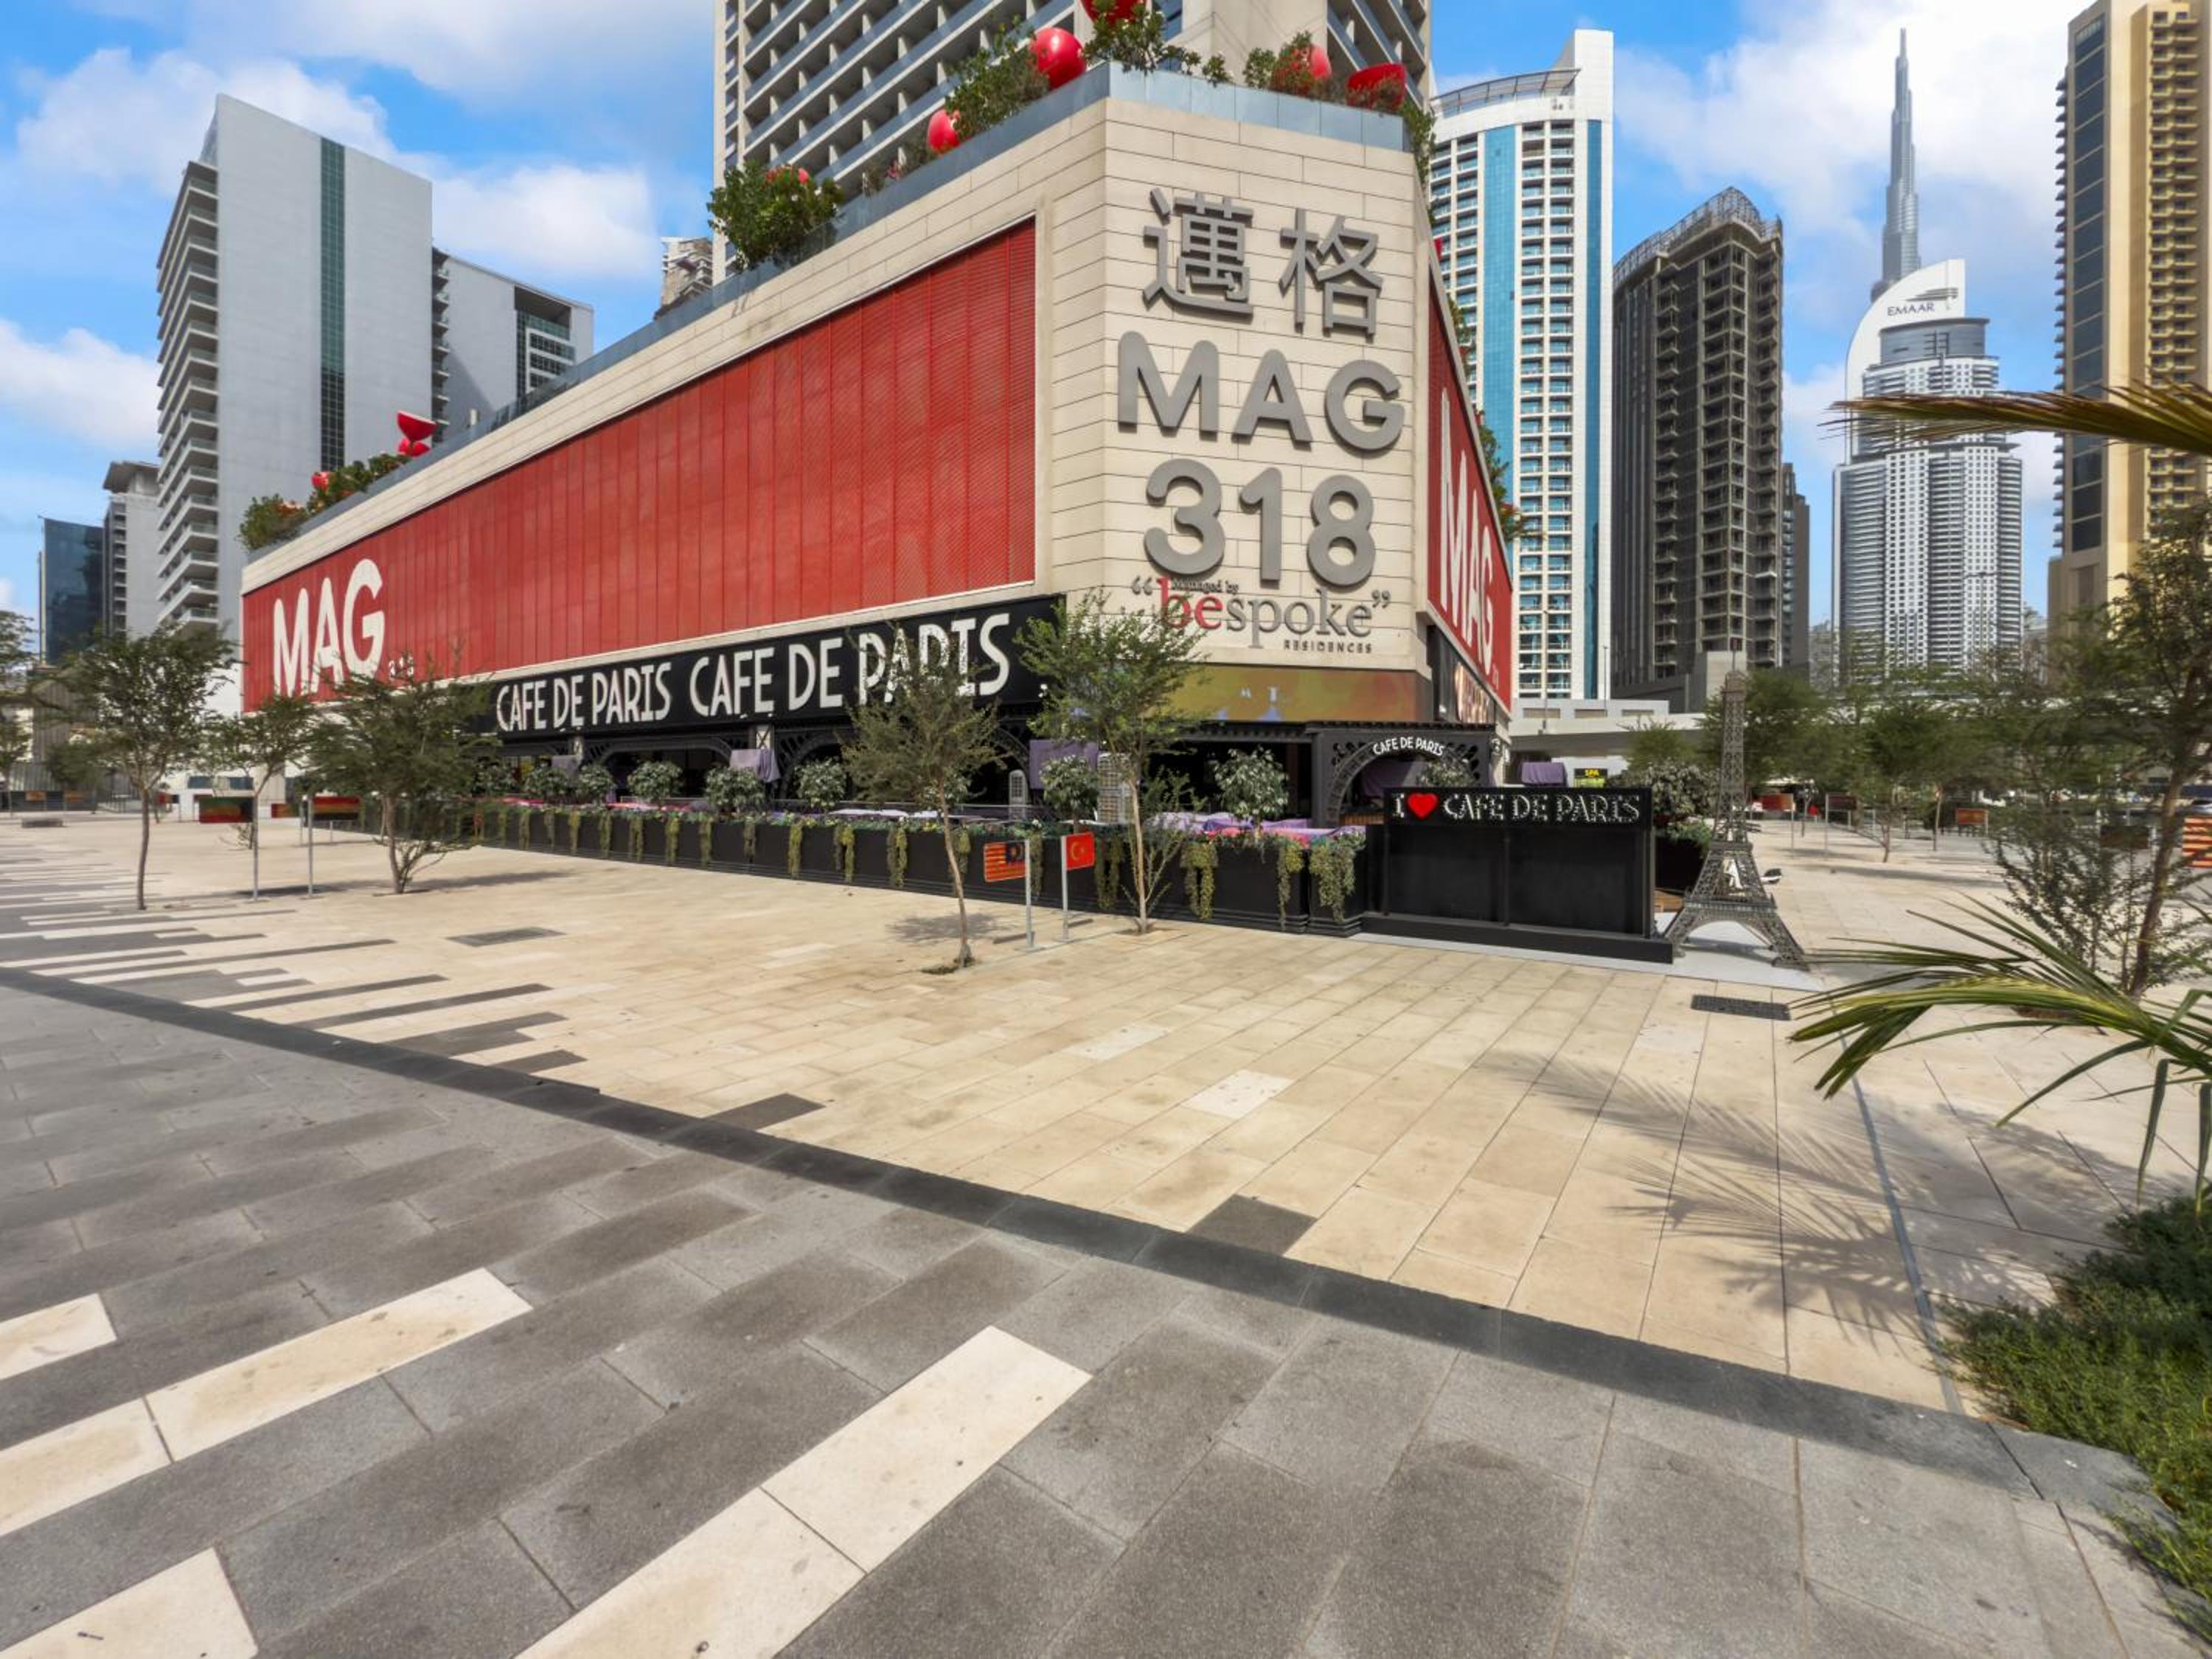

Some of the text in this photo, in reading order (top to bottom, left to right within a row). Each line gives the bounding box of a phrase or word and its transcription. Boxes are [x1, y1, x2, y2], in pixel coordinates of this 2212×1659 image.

[1887, 302, 1935, 316] EMAAR
[1116, 331, 1405, 451] MAG
[1144, 459, 1377, 587] 318
[1440, 388, 1493, 675] MAG
[274, 559, 385, 697] MAG
[1284, 639, 1372, 654] RESIDENCES
[496, 680, 546, 732] CAFE
[554, 675, 585, 728] DE
[592, 662, 672, 726] PARIS
[689, 647, 775, 715] CAFE
[788, 637, 843, 711] DE
[1372, 737, 1445, 757] CAFE DE PARIS
[1443, 793, 1505, 821] CAFE
[1512, 793, 1548, 822] DE
[1556, 793, 1641, 824] PARIS
